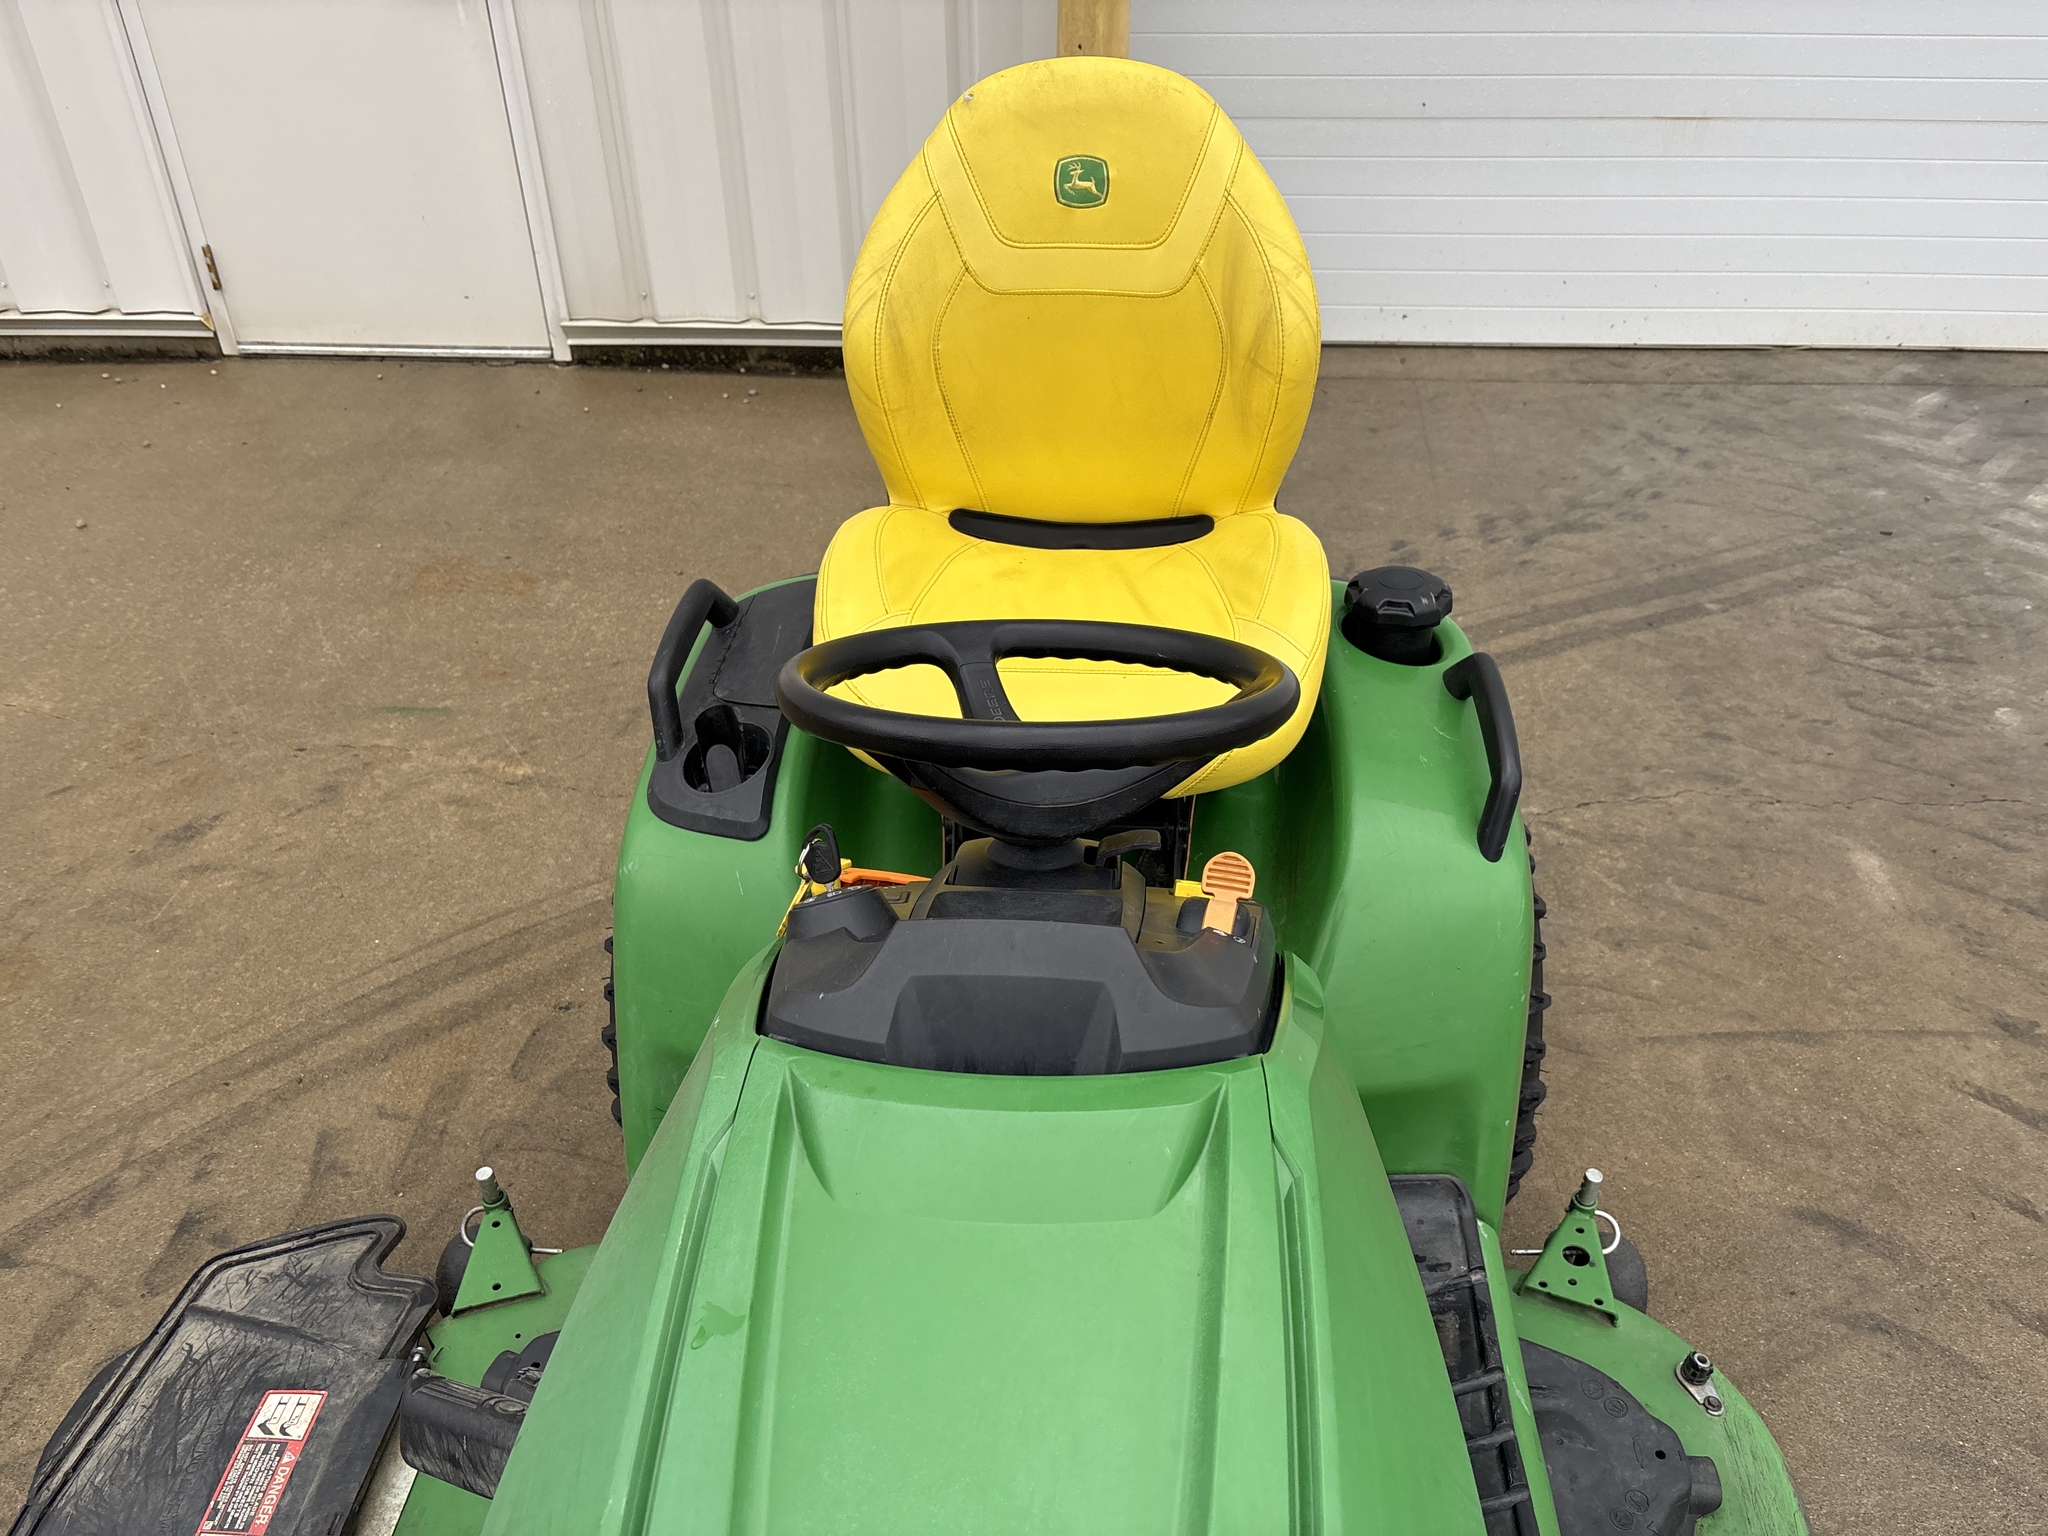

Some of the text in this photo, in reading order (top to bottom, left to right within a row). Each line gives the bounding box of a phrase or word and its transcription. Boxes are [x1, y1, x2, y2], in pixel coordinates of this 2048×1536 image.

[232, 1454, 266, 1517] THROWN OBJECTS
[248, 1492, 263, 1516] BLADE
[253, 1466, 290, 1524] DANGER
